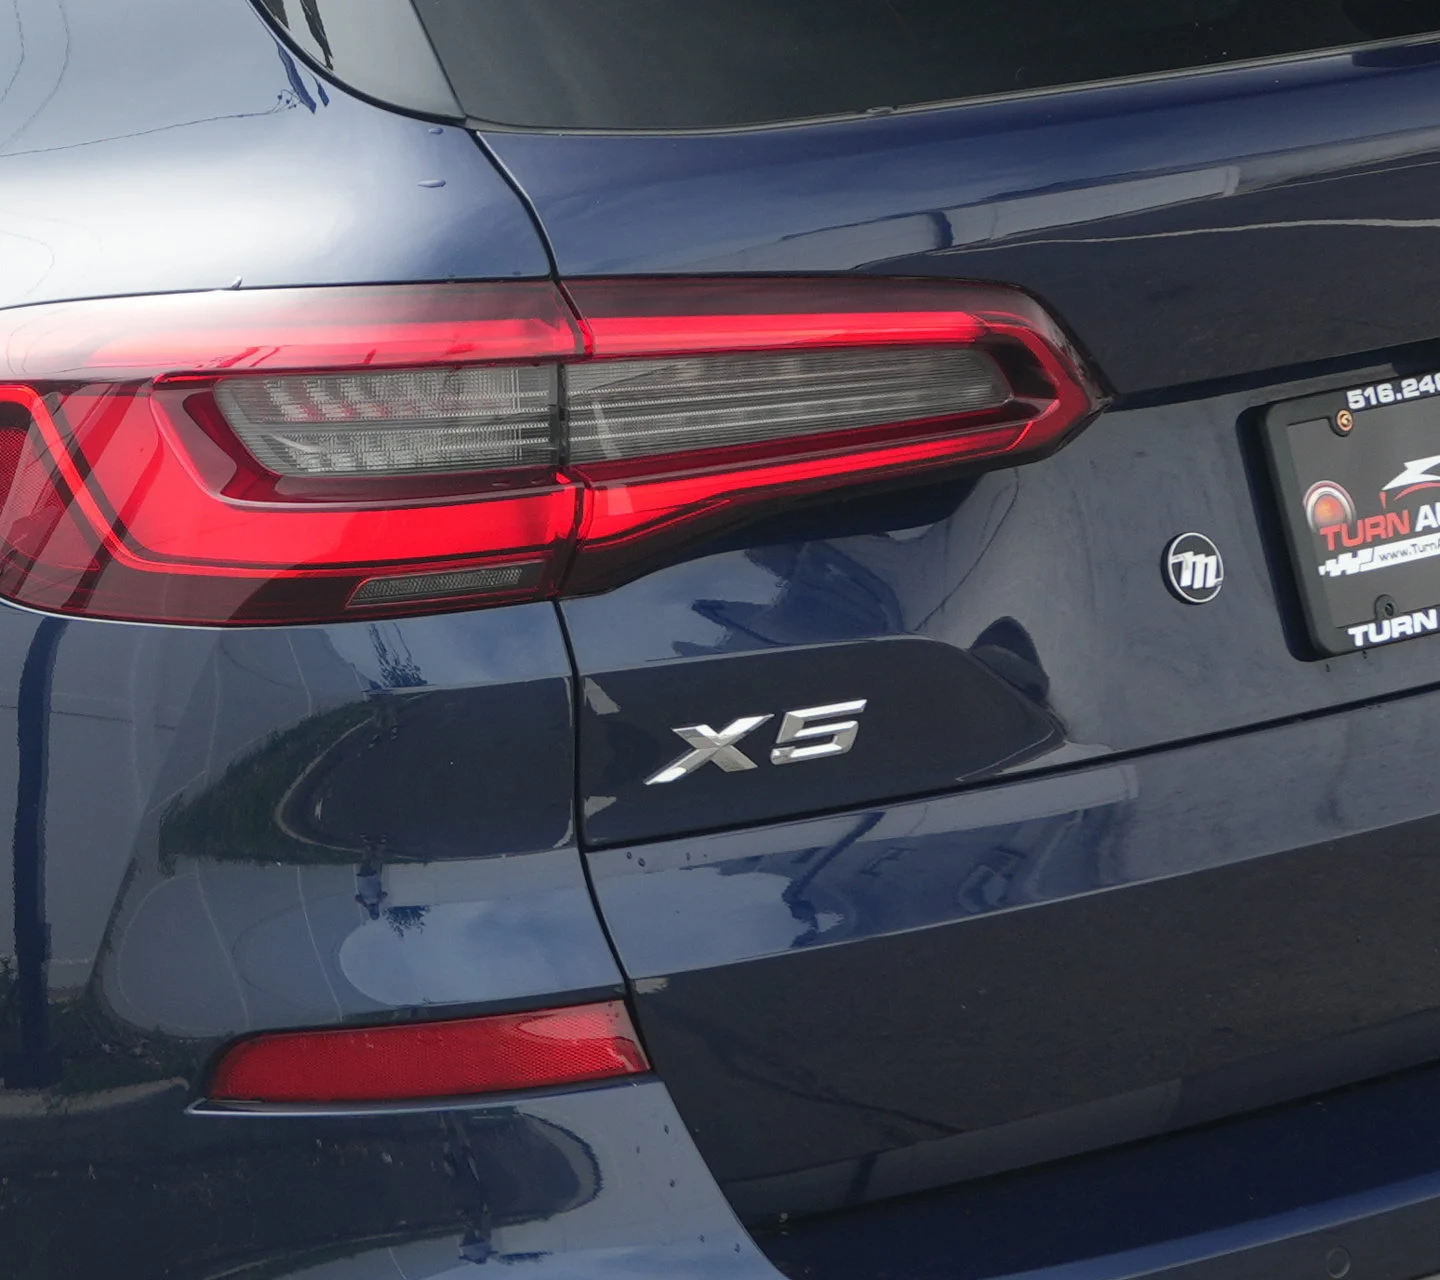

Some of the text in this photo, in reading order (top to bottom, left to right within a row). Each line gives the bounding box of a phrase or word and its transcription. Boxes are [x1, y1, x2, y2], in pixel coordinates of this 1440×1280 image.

[1320, 510, 1411, 551] TURN
[1348, 609, 1438, 647] TURN
[643, 699, 868, 786] X5
